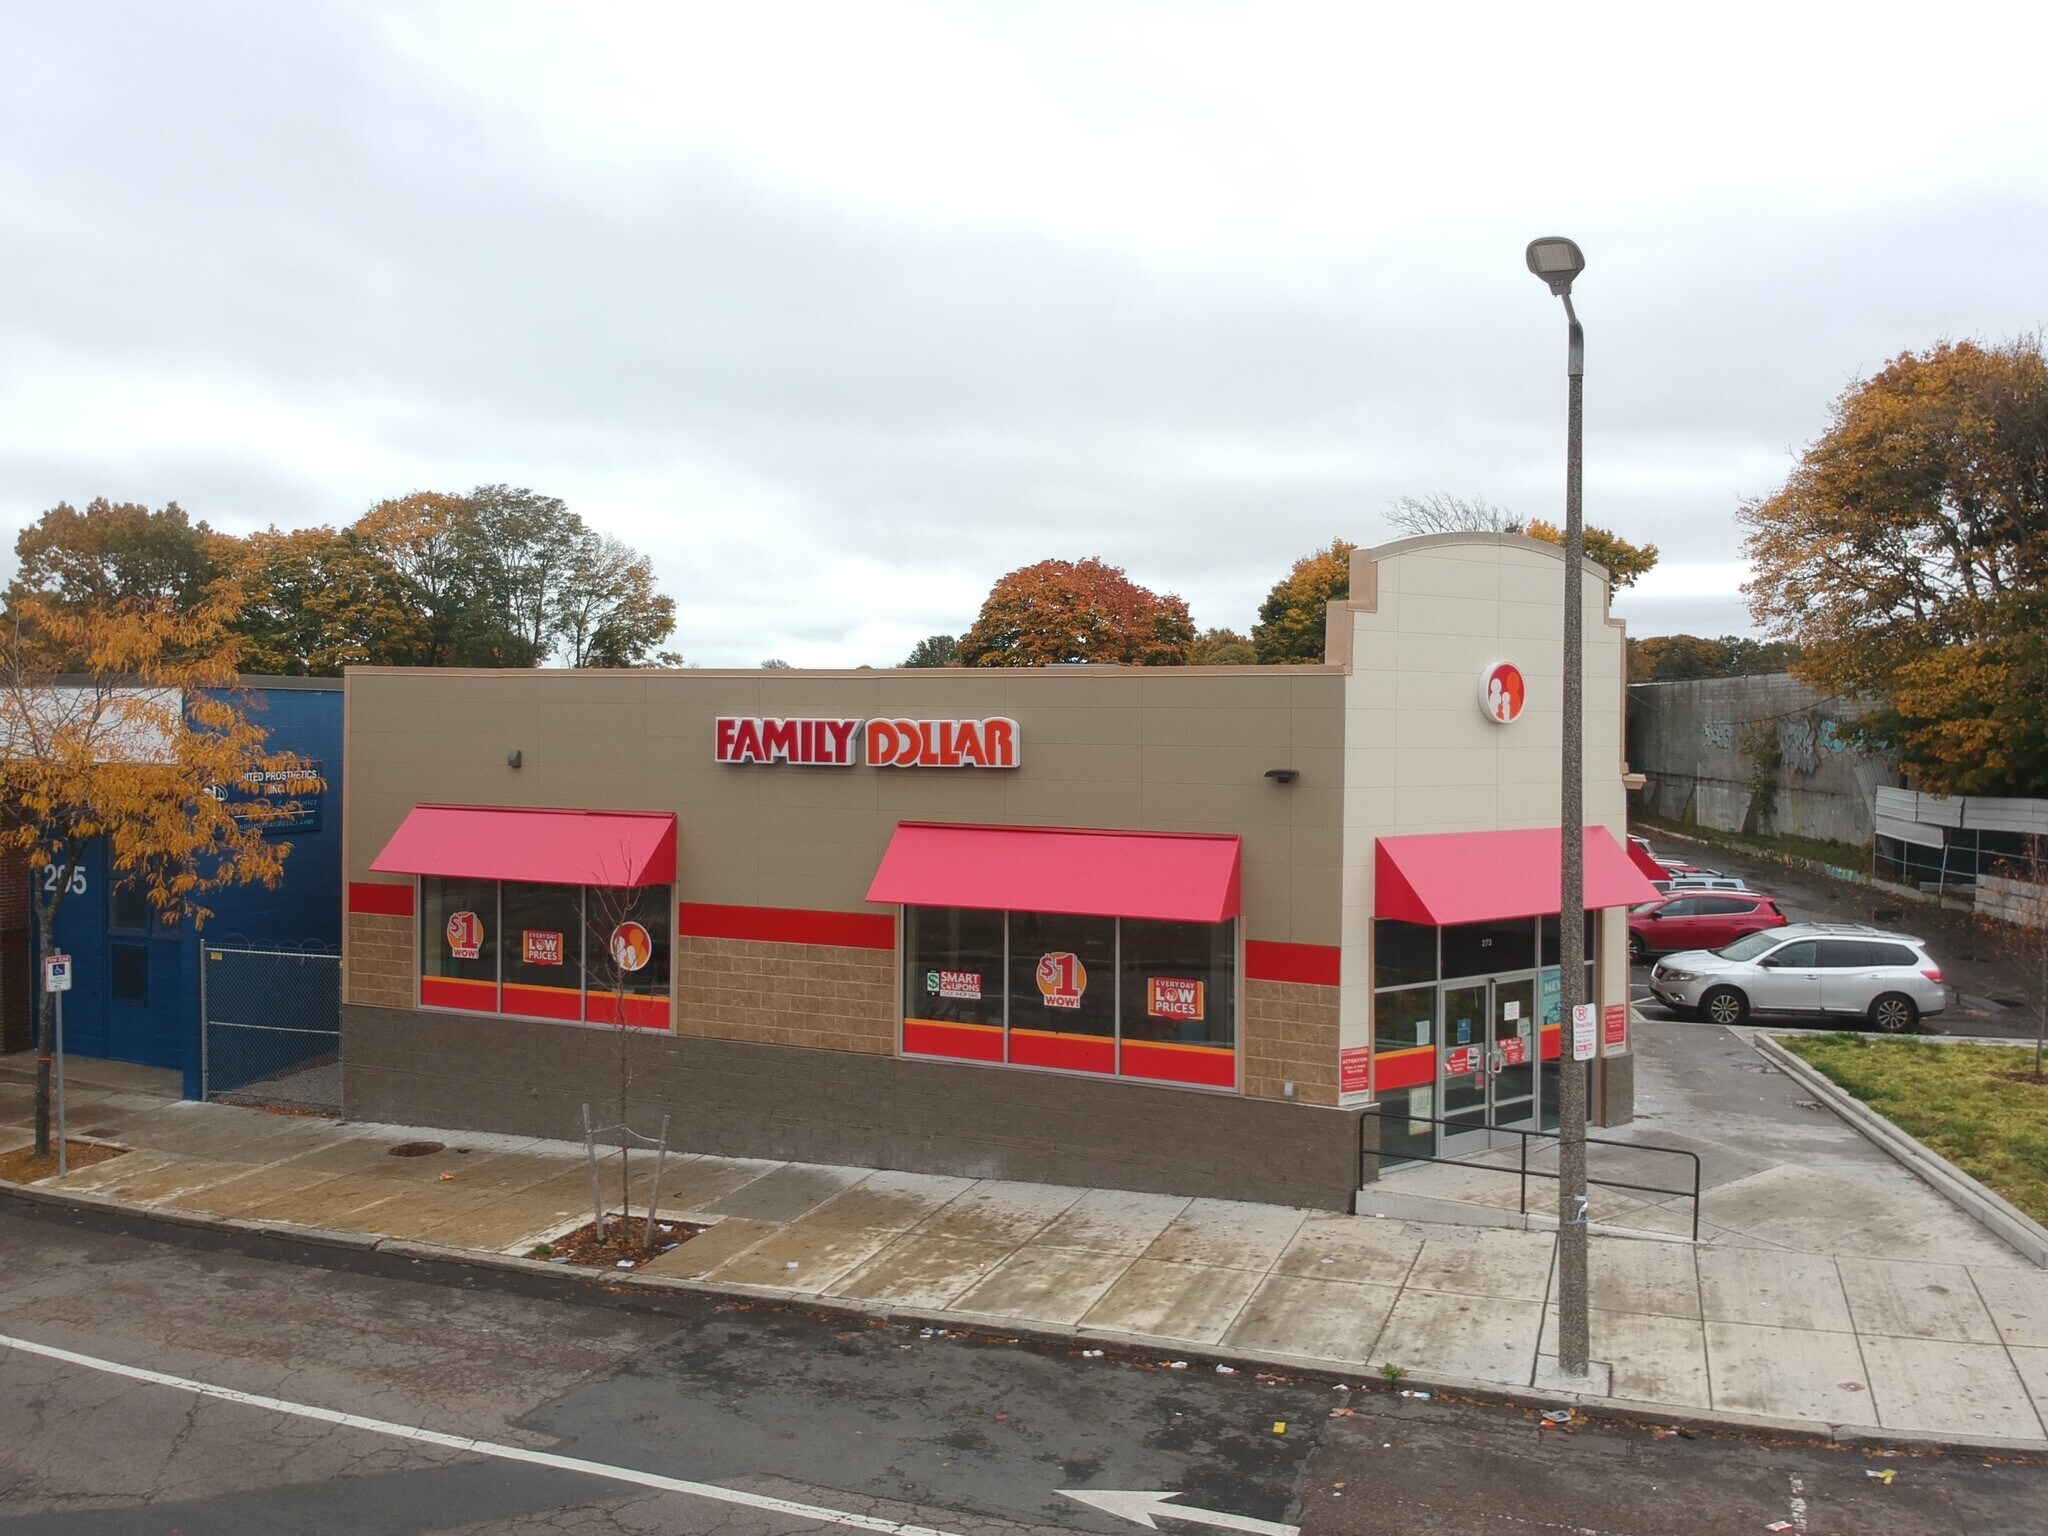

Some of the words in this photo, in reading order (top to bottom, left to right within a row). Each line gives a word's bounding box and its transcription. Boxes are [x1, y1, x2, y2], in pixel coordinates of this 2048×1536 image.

[716, 717, 859, 764] FAMILY
[866, 719, 1015, 766] DOLLAR
[265, 770, 317, 781] PROSTHETICS
[451, 913, 477, 948] $1
[528, 932, 557, 940] EVERYDAY
[528, 939, 557, 951] LOW
[1481, 939, 1492, 947] 273
[454, 948, 479, 958] WOW!
[528, 950, 557, 961] PRICES
[941, 972, 980, 984] SMART
[1041, 953, 1080, 996] $1
[1155, 979, 1195, 989] EVERYDAY
[1156, 988, 1195, 1001] LOW
[1045, 996, 1079, 1007] WOW!
[1155, 1001, 1195, 1014] PRICES
